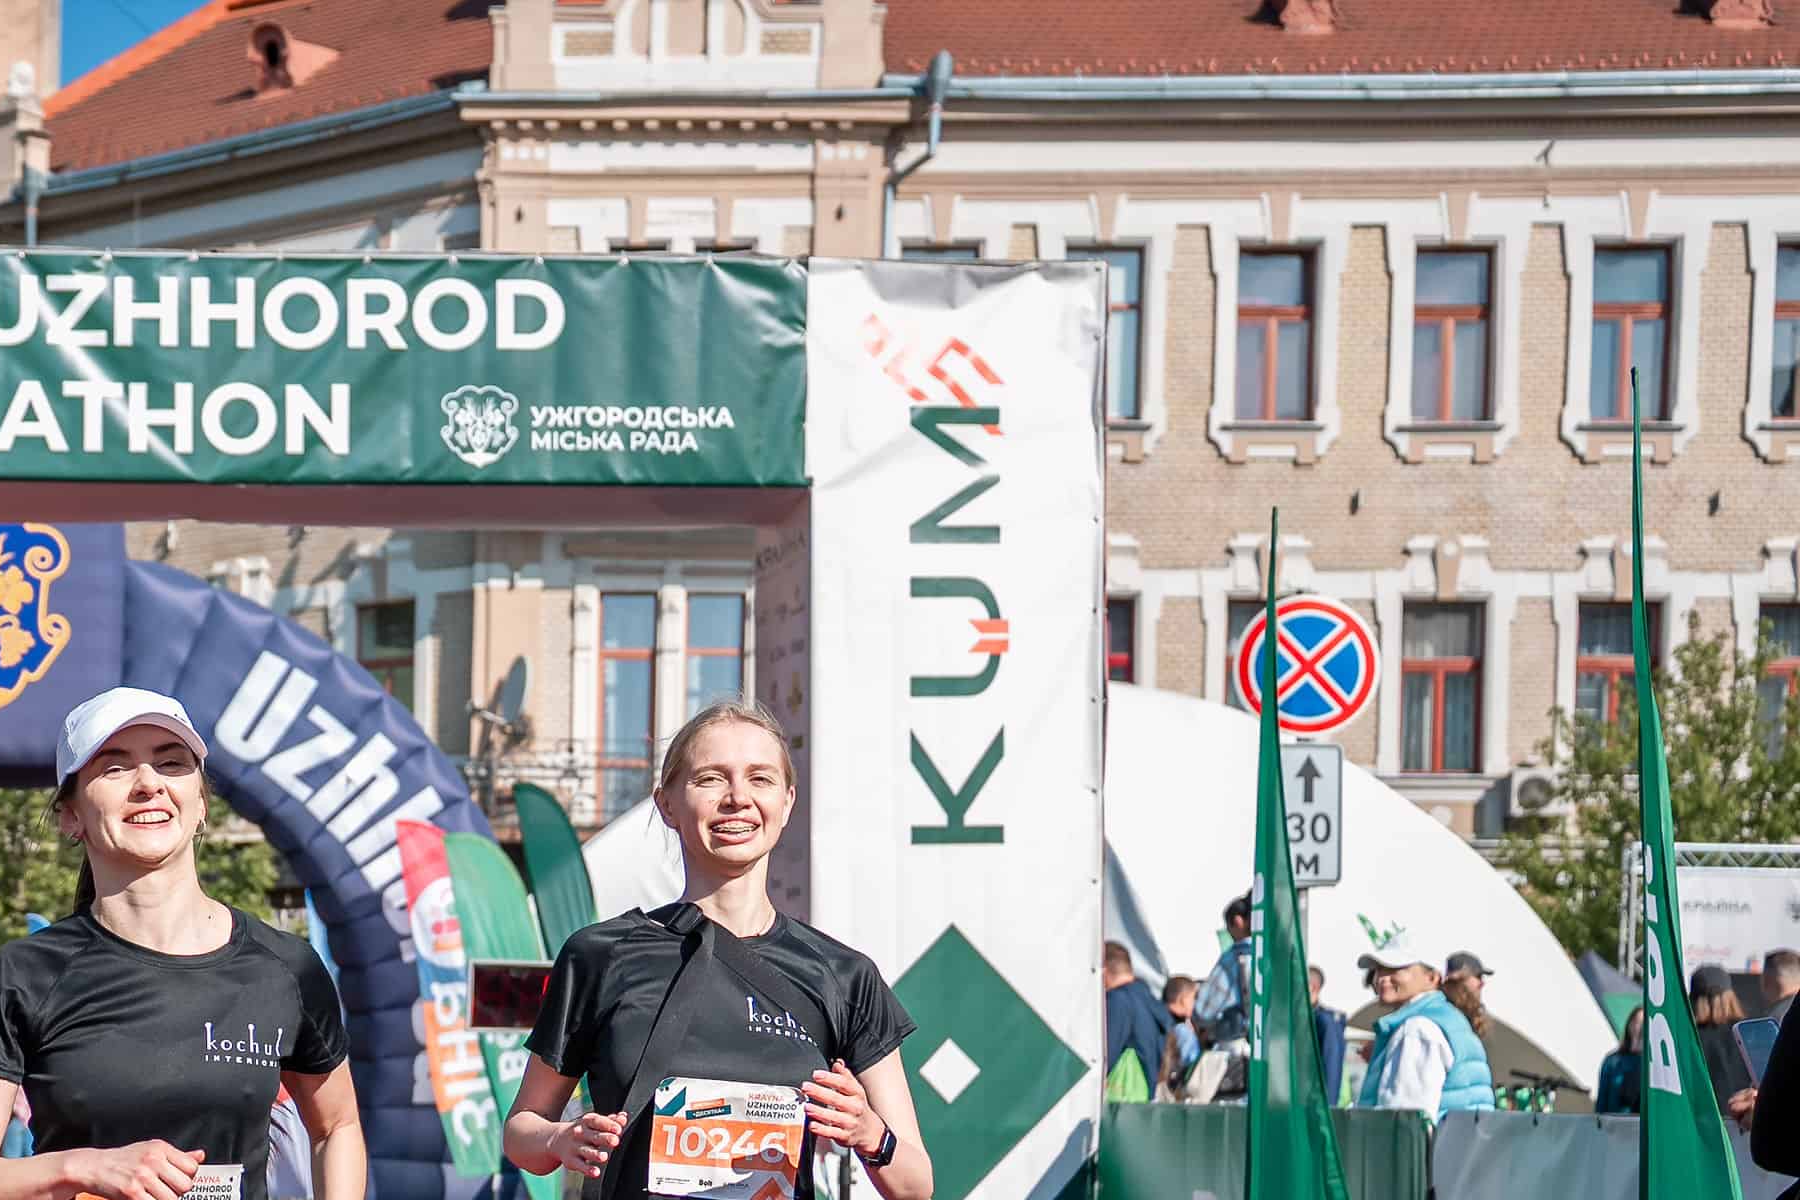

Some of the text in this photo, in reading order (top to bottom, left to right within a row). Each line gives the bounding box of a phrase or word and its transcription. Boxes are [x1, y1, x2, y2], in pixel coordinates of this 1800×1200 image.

[529, 405, 735, 430] УЖГОРОДСЬКА
[530, 430, 699, 454] МІСЬКА РАДА
[1286, 812, 1331, 844] 30
[745, 1110, 796, 1119] MARATHON
[747, 1102, 797, 1111] UZHHOROD
[662, 1124, 786, 1164] 10246
